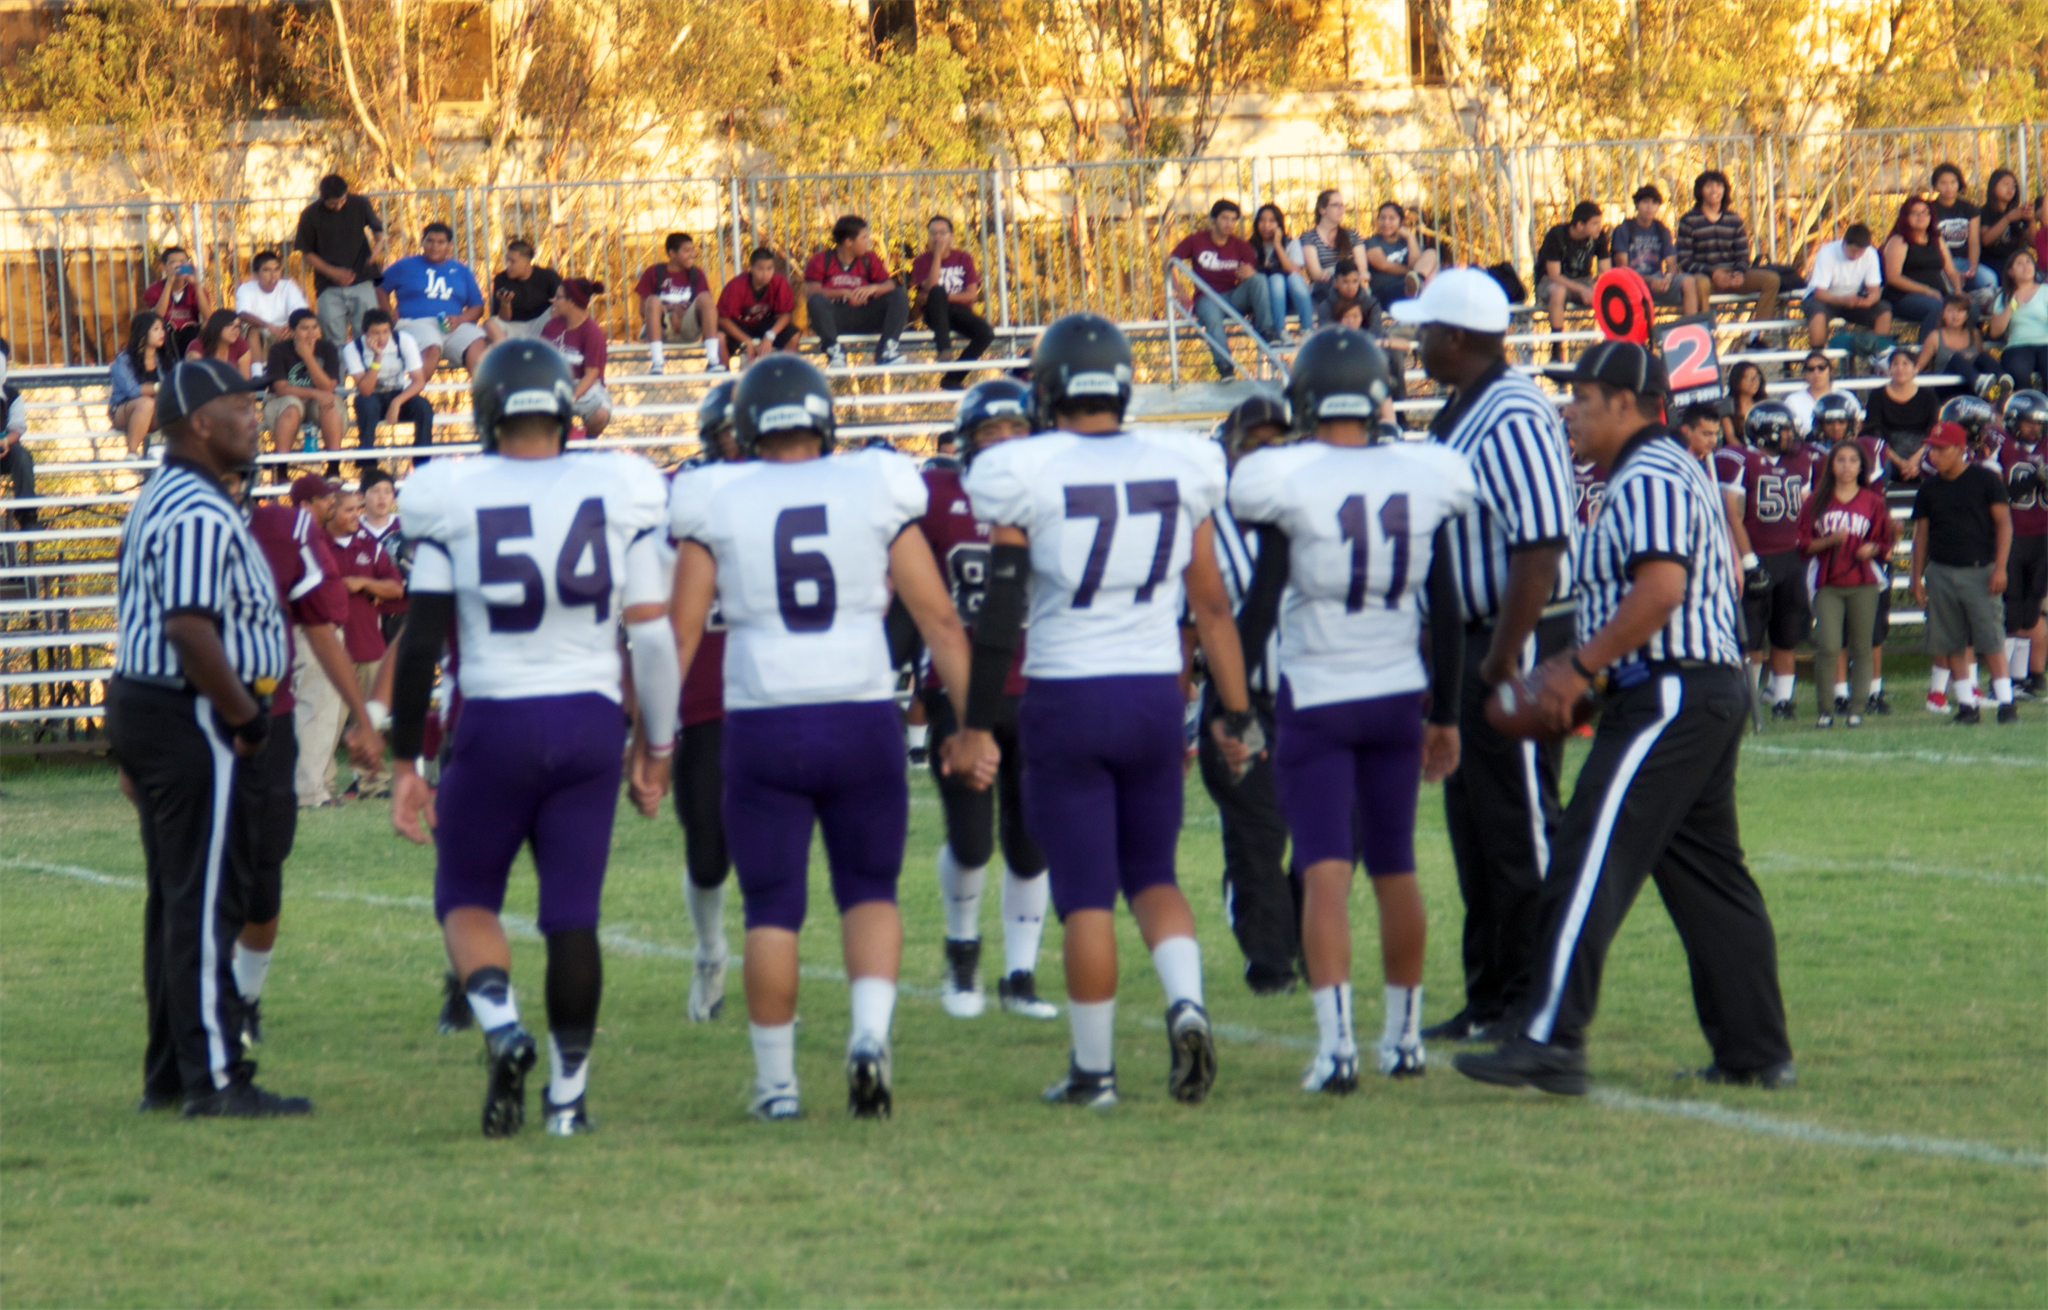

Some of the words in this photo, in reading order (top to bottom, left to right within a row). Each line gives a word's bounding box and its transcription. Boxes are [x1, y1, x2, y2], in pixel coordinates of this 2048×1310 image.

[424, 268, 453, 300] LA
[1663, 323, 1718, 390] 2
[1063, 479, 1179, 609] 77
[1336, 492, 1409, 614] 11
[1757, 474, 1803, 523] 50
[476, 496, 612, 634] 54
[773, 504, 837, 634] 6
